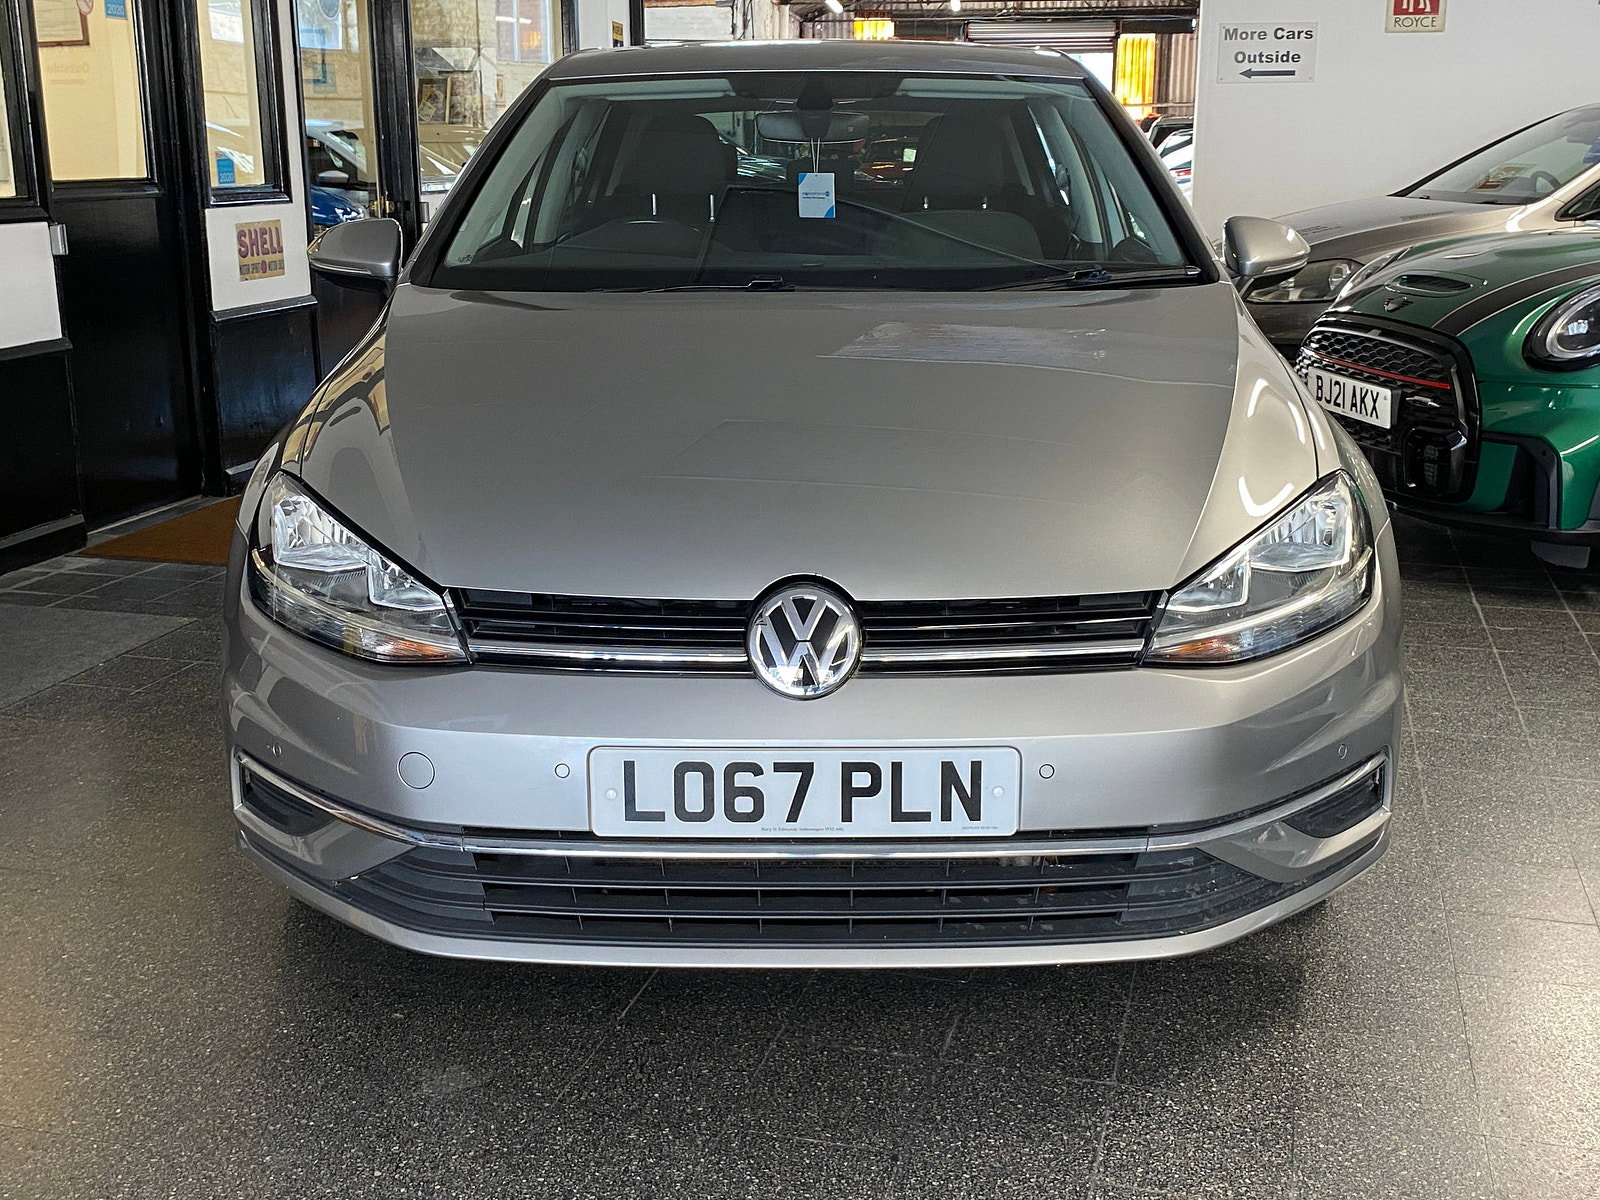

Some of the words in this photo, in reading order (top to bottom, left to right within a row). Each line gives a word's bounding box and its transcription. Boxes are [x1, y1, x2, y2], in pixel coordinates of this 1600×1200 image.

[1393, 16, 1437, 28] ROYCE
[1224, 27, 1268, 41] More
[1273, 27, 1314, 40] Cars
[1233, 50, 1301, 64] Outside
[236, 226, 284, 259] SHELL
[1316, 375, 1345, 408] BJ21
[1350, 386, 1379, 419] AKX
[623, 760, 815, 823] LO67
[840, 760, 982, 823] PLN
